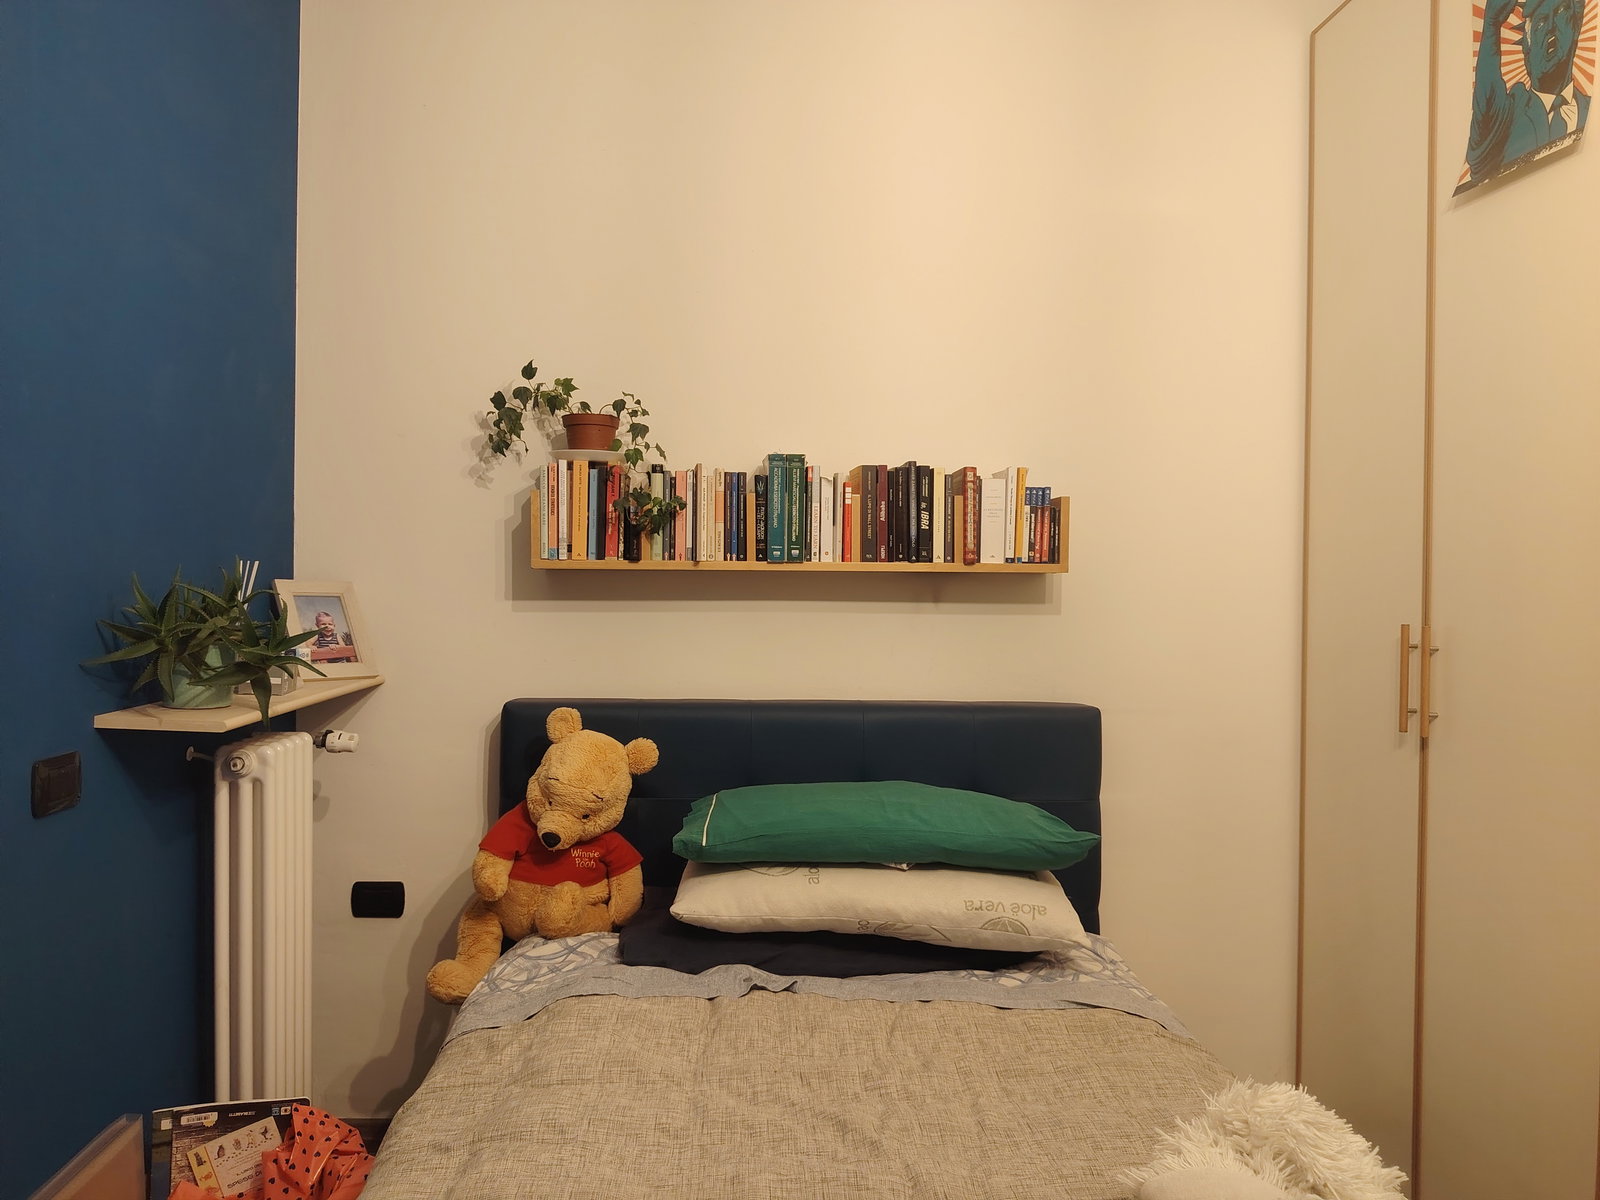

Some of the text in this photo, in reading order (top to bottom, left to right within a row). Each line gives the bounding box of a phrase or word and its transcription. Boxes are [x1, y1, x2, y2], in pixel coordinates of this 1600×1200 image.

[921, 511, 929, 529] IBRA
[570, 848, 600, 858] Winnie
[575, 858, 596, 868] Pooh
[963, 900, 1047, 920] aloë vera
